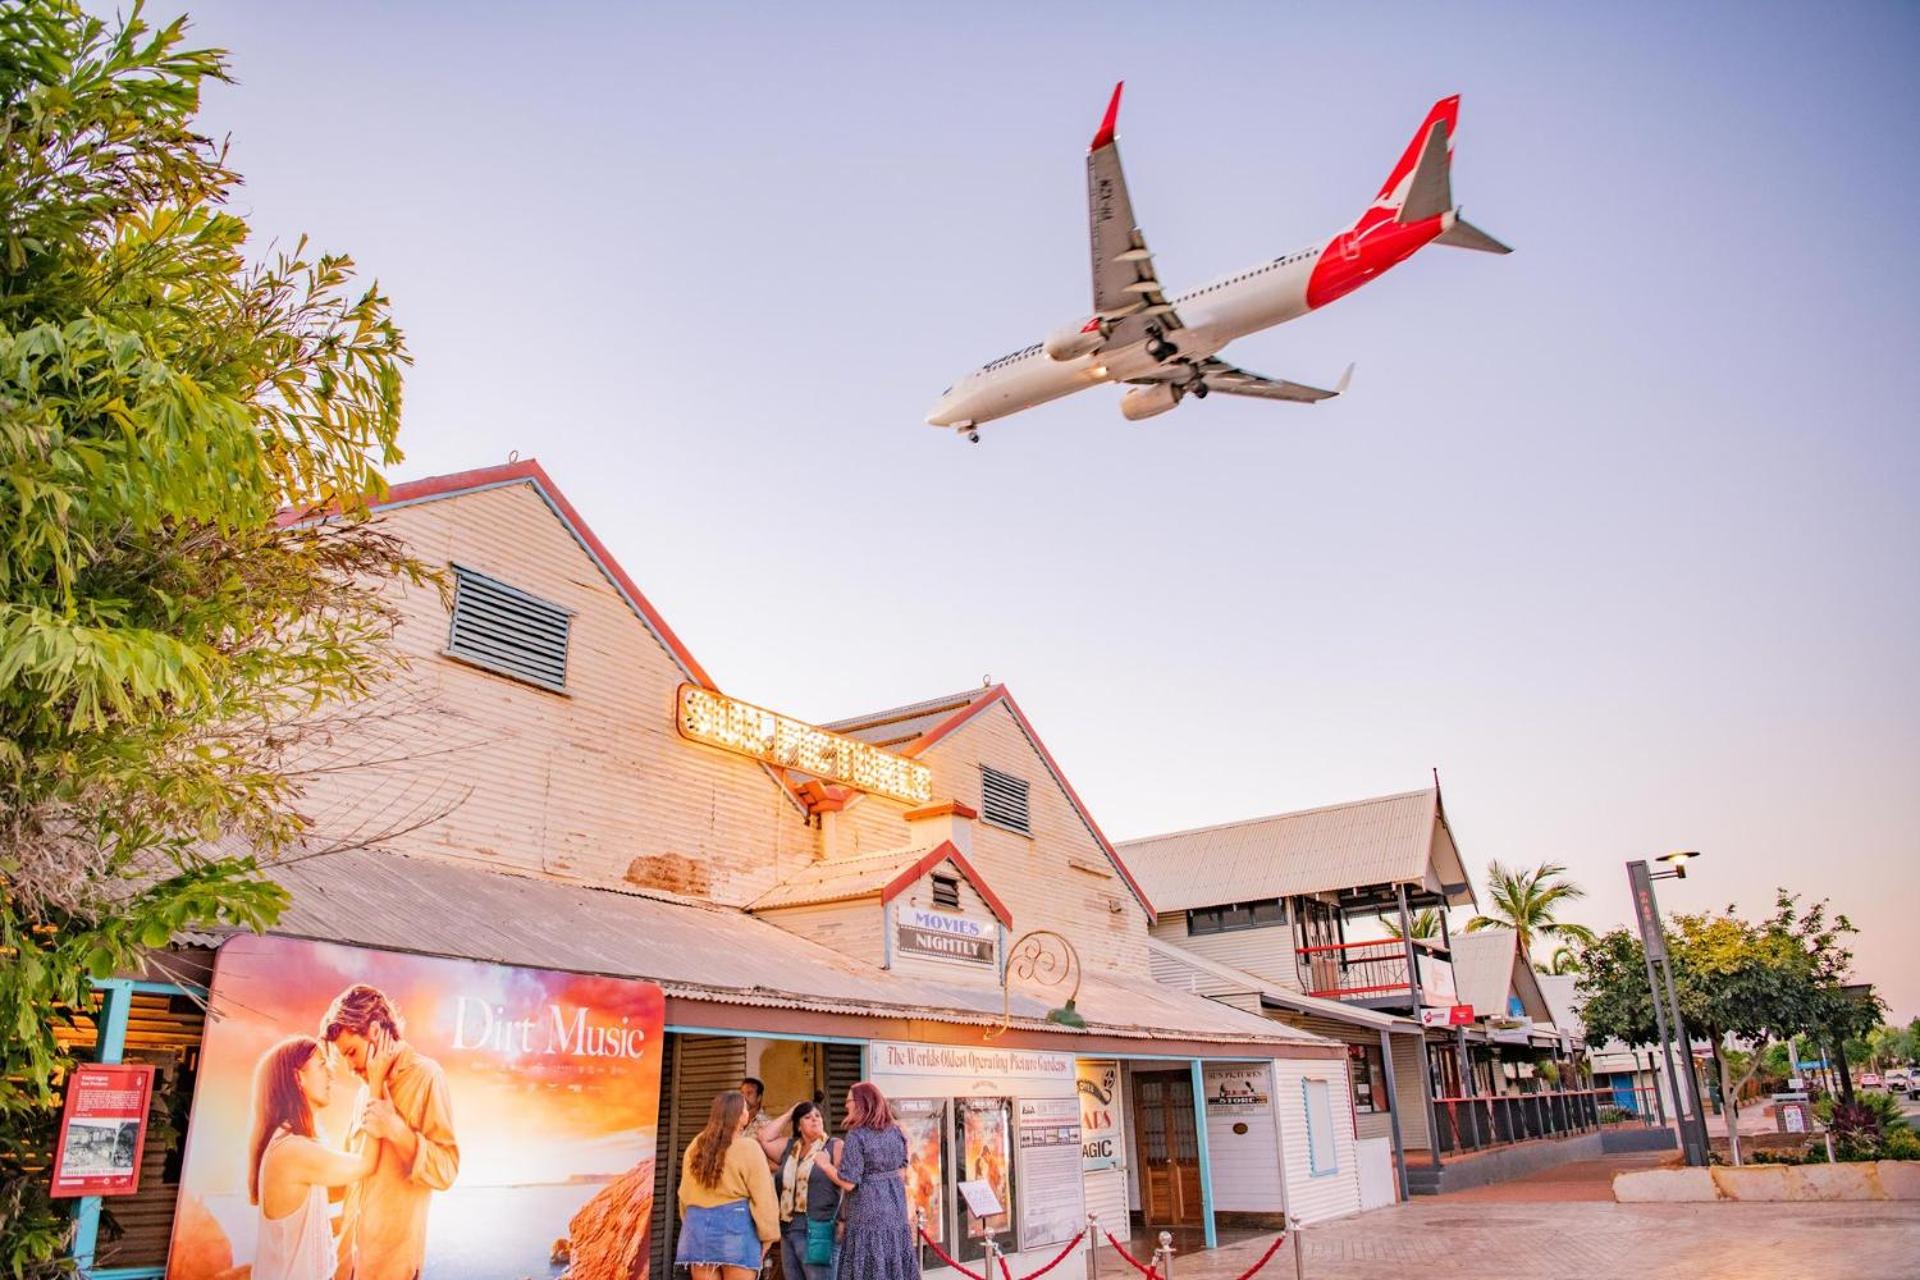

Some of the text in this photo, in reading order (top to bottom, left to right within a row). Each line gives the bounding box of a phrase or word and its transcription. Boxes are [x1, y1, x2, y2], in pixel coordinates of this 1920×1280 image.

[915, 912, 980, 936] MOVIES
[915, 933, 980, 956] NIGHTLY
[451, 996, 646, 1060] Dirt Music
[887, 1046, 905, 1066] The
[940, 1048, 967, 1068] Oldest
[968, 1051, 1008, 1073] Operating
[1082, 1140, 1113, 1158] AGIC
